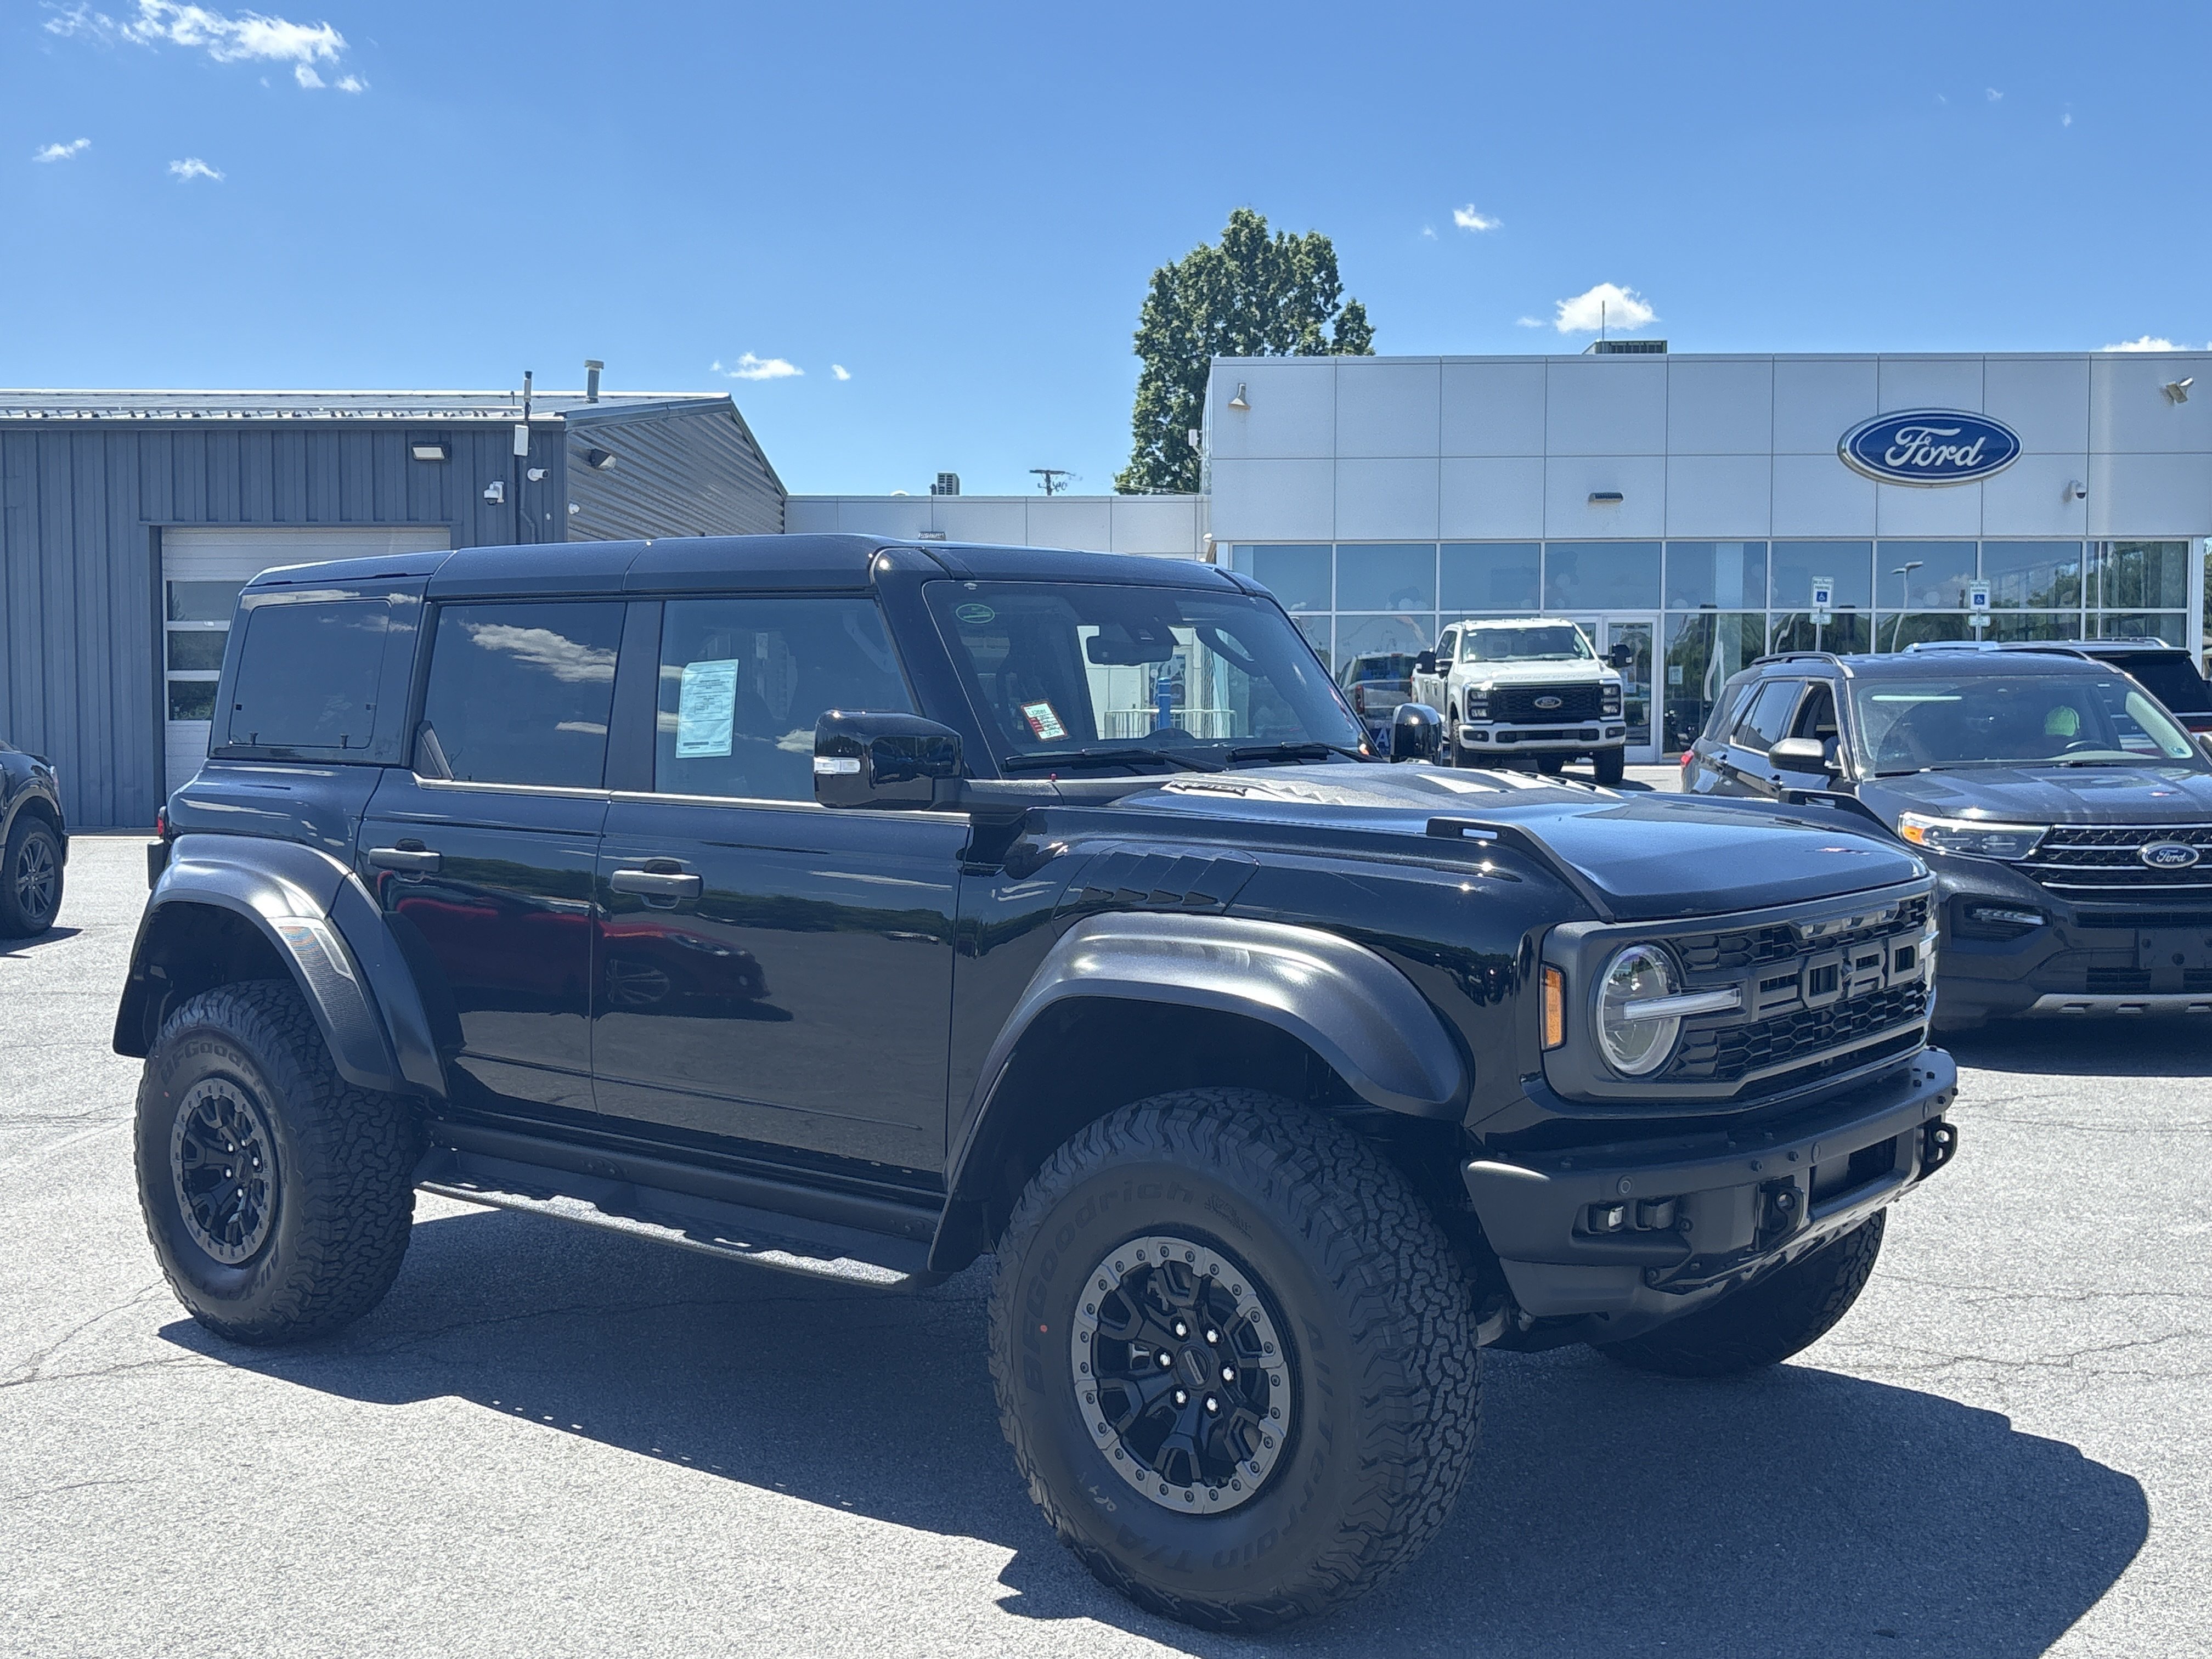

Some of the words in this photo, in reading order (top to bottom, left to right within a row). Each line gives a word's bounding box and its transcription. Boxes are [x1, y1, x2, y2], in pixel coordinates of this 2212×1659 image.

[1884, 426, 1987, 467] Ford
[2156, 849, 2187, 863] Ford
[1751, 930, 1923, 1023] FORD
[1023, 1180, 1194, 1395] BFGoodrich
